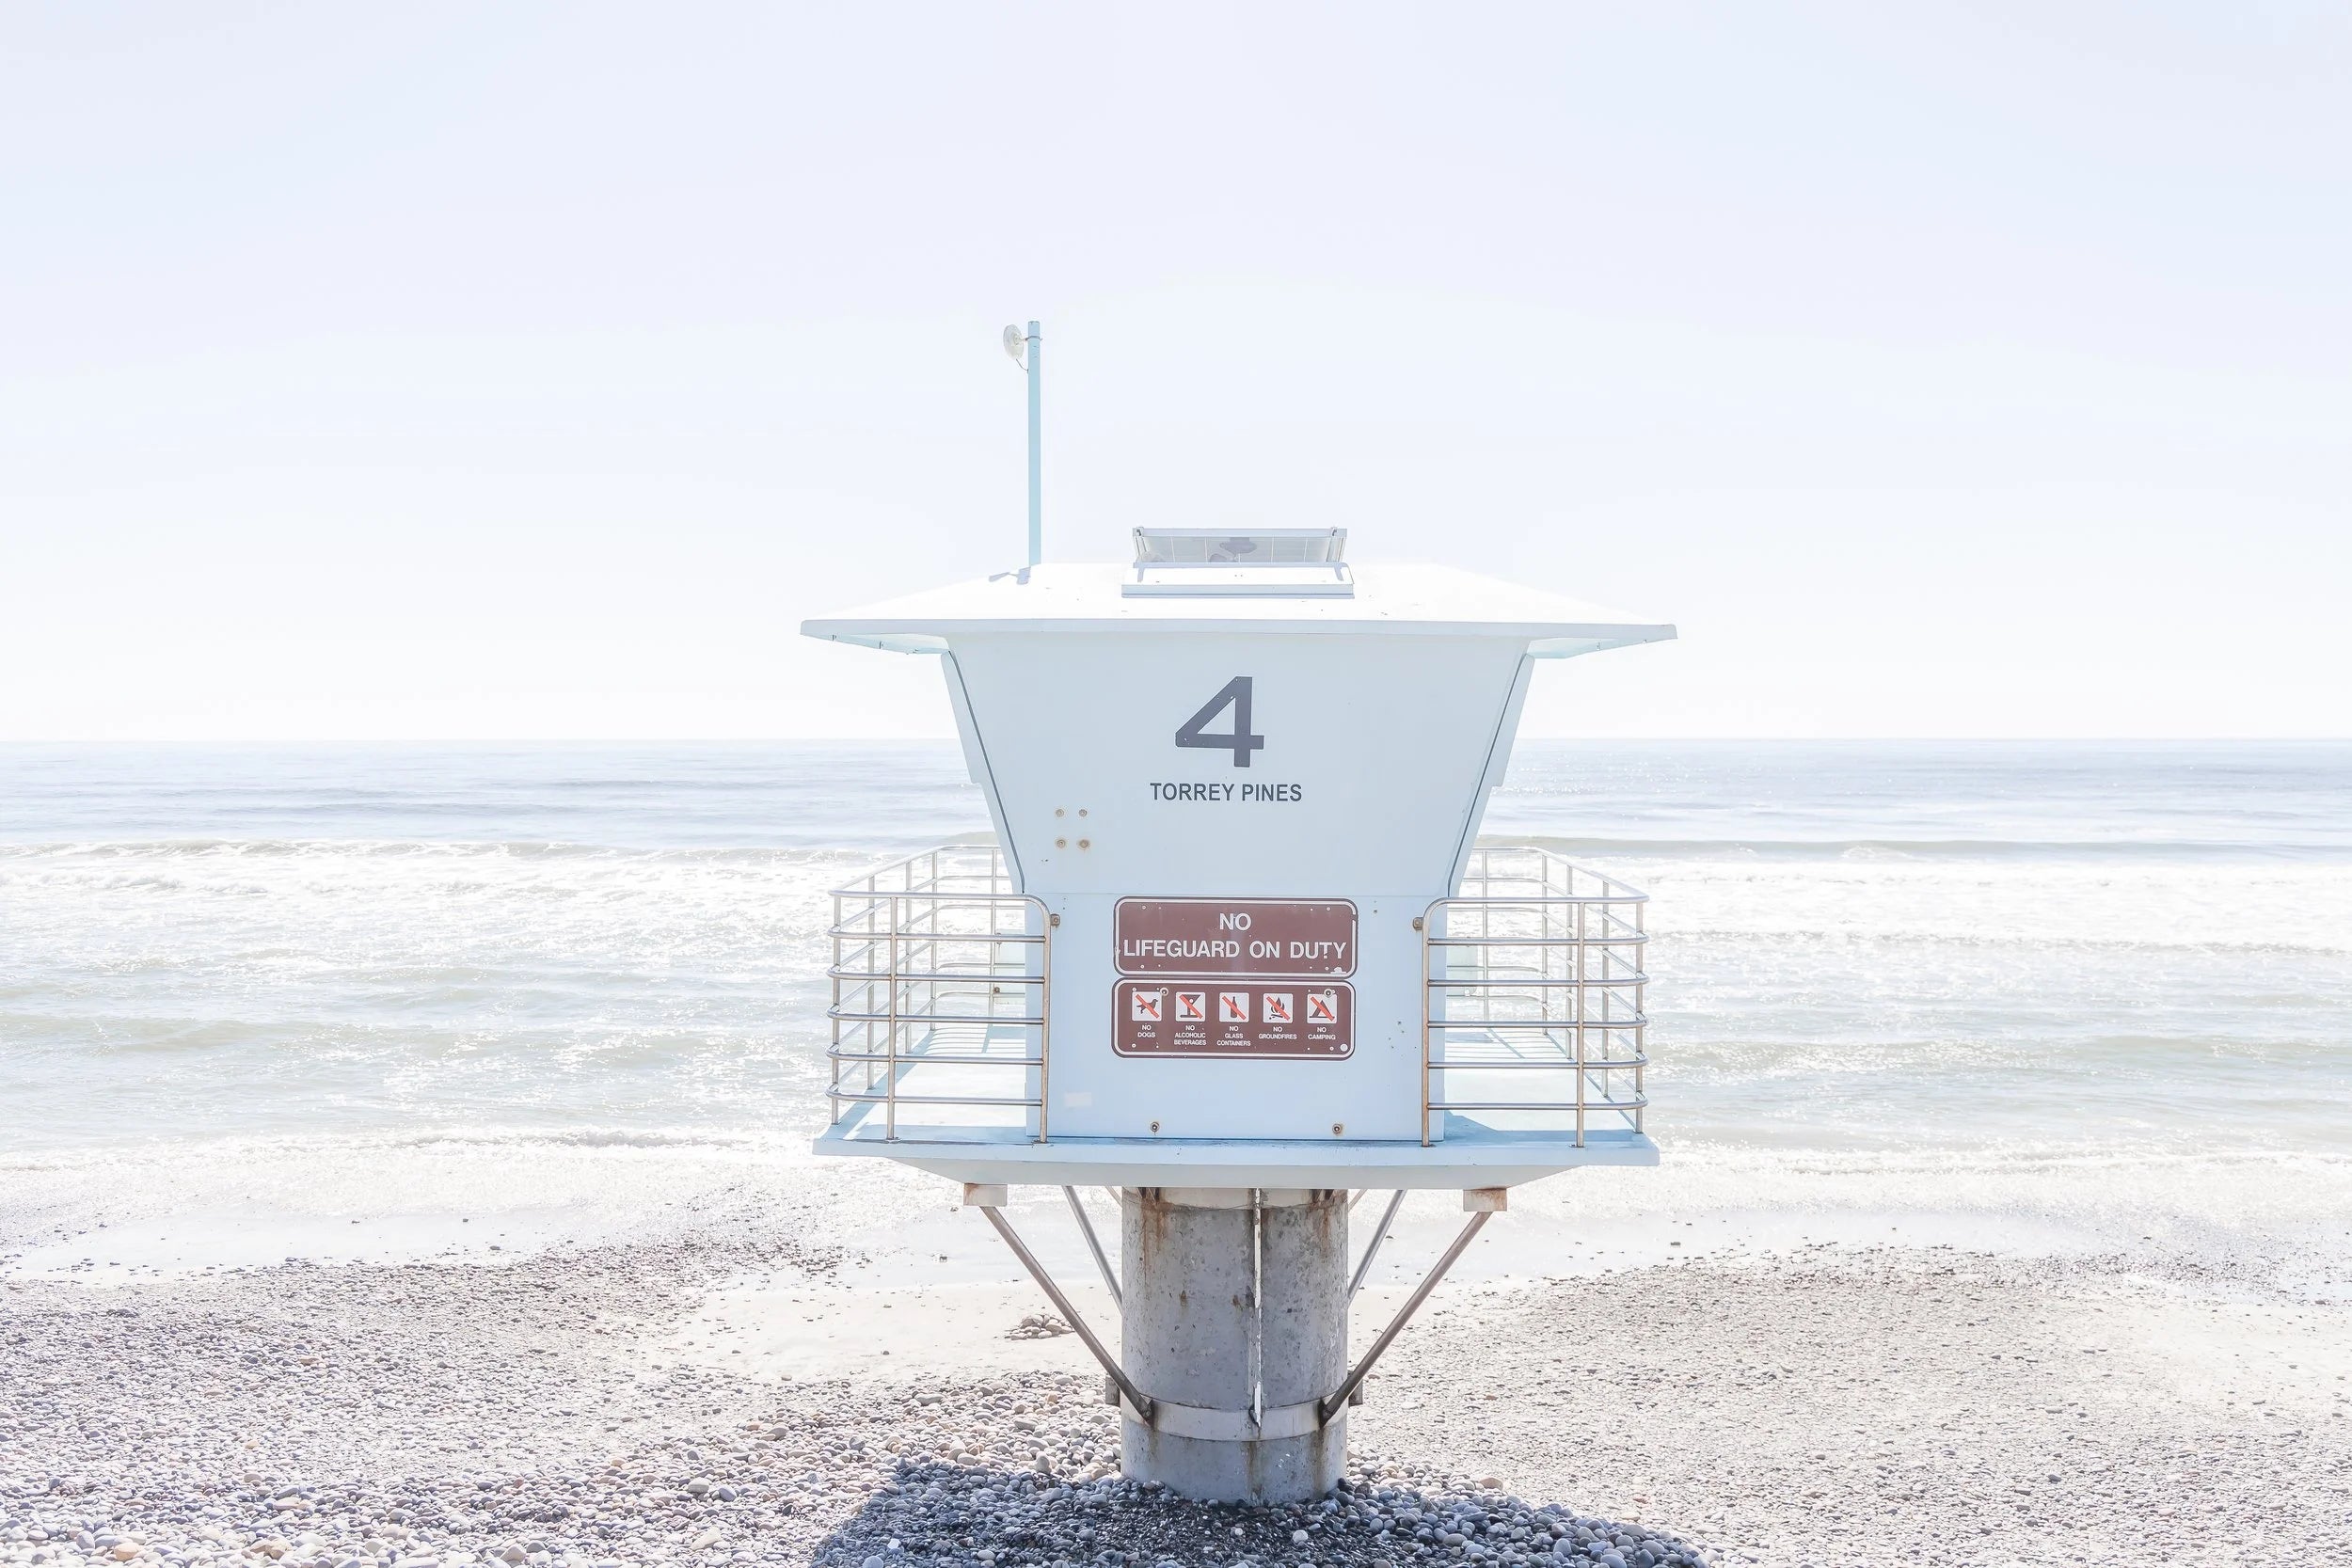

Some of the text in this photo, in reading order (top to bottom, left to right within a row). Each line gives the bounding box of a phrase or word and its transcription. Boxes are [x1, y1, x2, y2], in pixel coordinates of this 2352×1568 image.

[1175, 675, 1264, 768] 4
[1150, 783, 1302, 802] TORREY PINES
[1219, 912, 1252, 931] NO
[1123, 939, 1347, 959] LIFEGUARD ON DUTY
